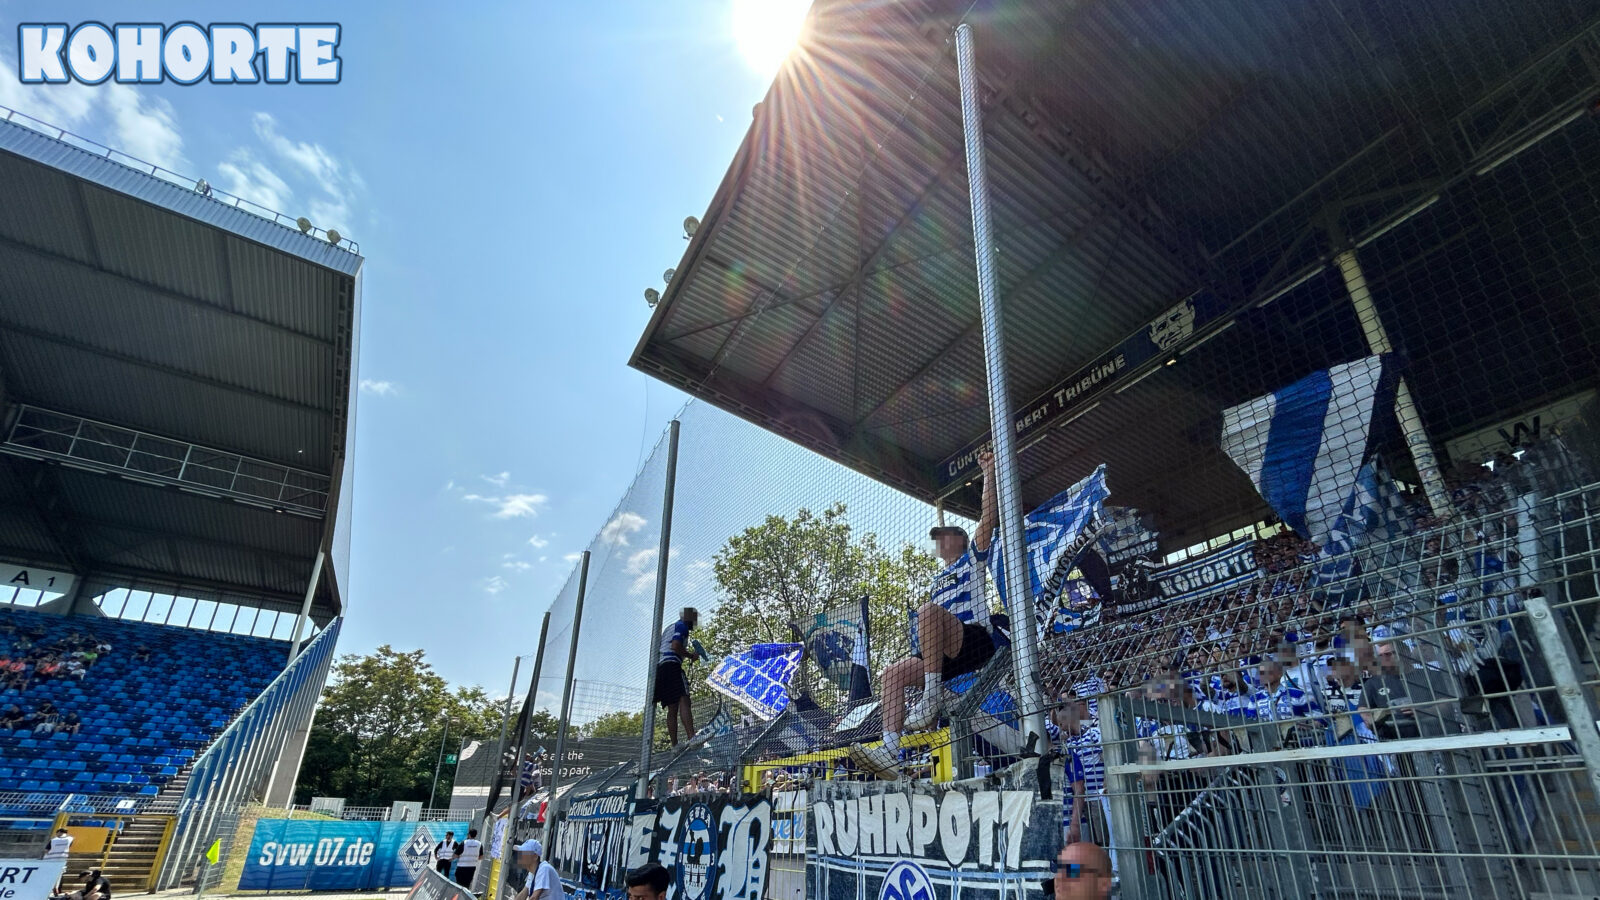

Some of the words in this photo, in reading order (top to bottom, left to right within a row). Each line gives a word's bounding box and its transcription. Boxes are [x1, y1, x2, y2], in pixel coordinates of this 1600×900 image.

[1054, 354, 1126, 408] TRIBÜNE
[10, 570, 29, 585] A
[48, 576, 55, 587] 1
[1159, 550, 1257, 596] KOHORTE
[567, 750, 585, 761] the
[568, 766, 593, 777] part.
[813, 790, 1033, 871] RUHRPOTT
[0, 867, 39, 884] RT
